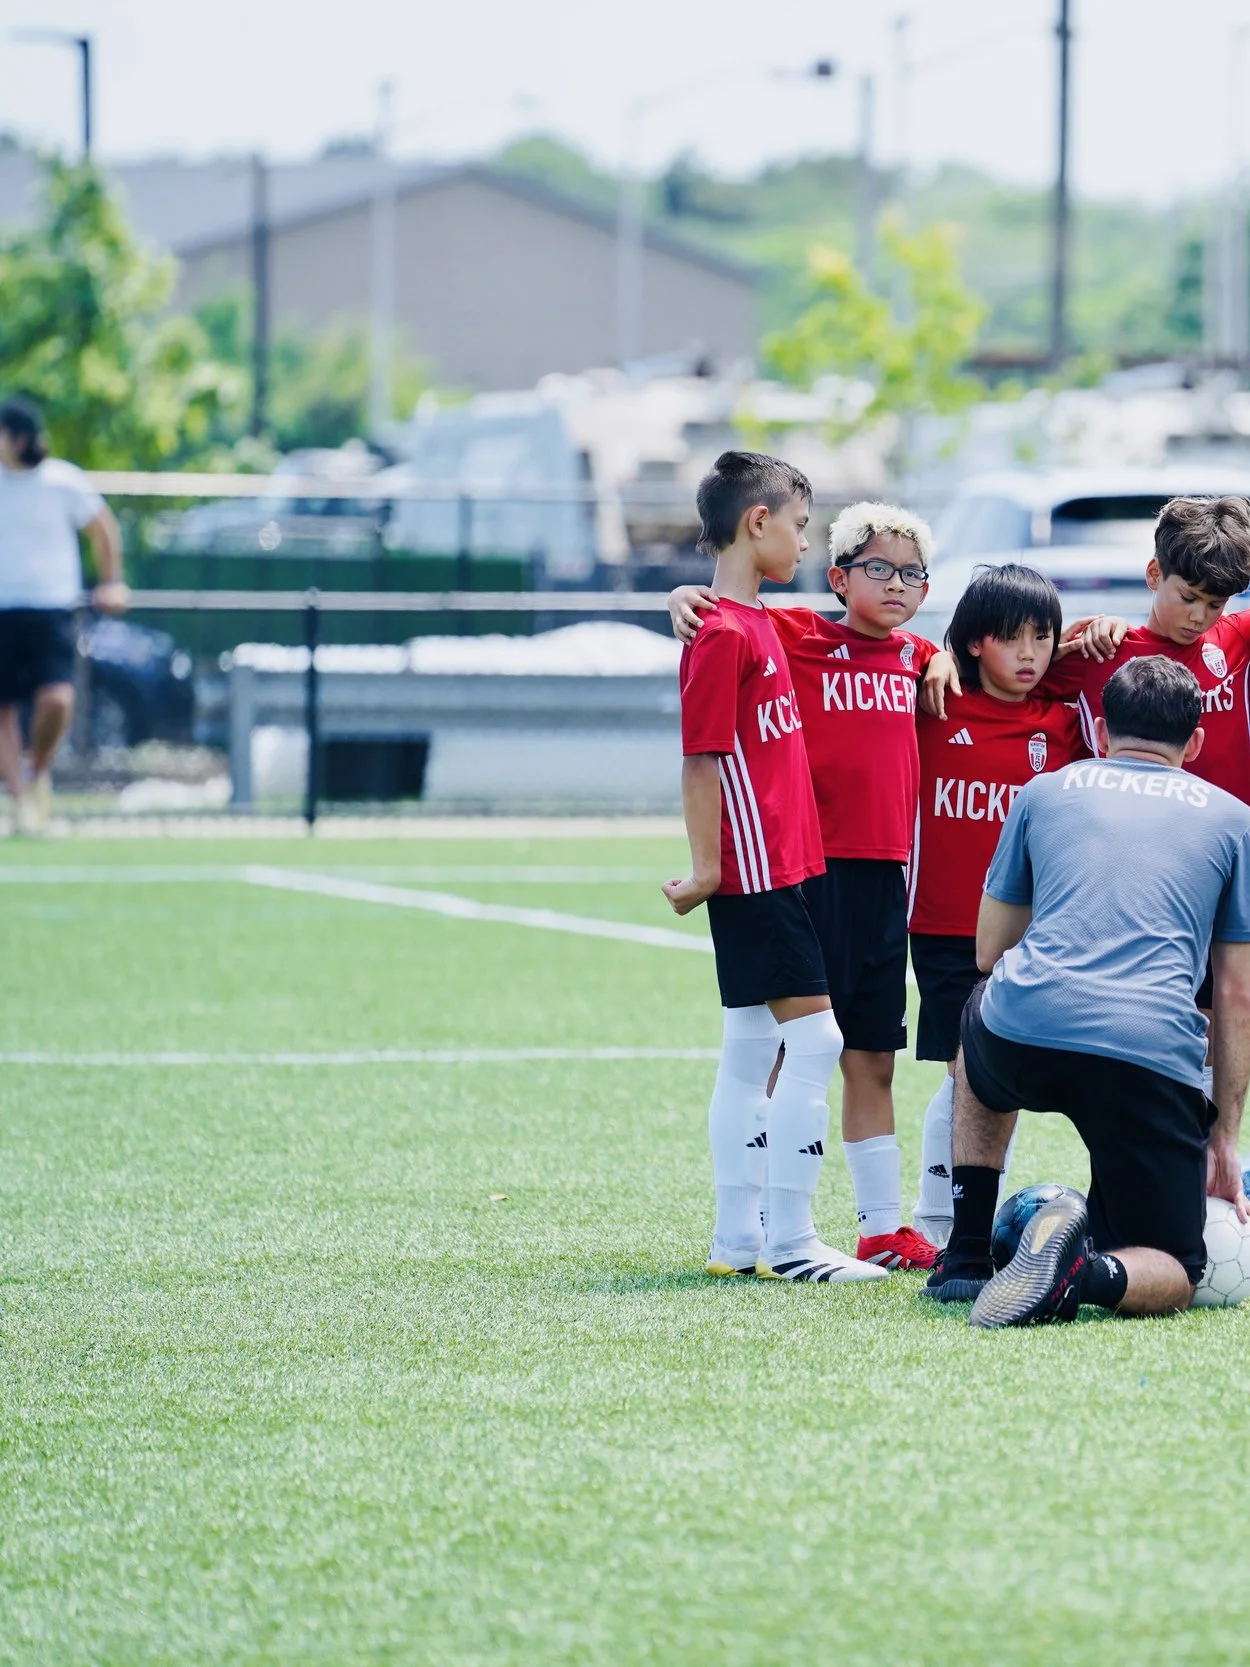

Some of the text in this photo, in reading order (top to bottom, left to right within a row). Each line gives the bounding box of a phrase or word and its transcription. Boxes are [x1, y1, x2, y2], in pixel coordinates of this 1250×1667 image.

[822, 672, 917, 715] KICKER
[934, 777, 1025, 823] KICK
[1063, 766, 1211, 808] KICKERS
